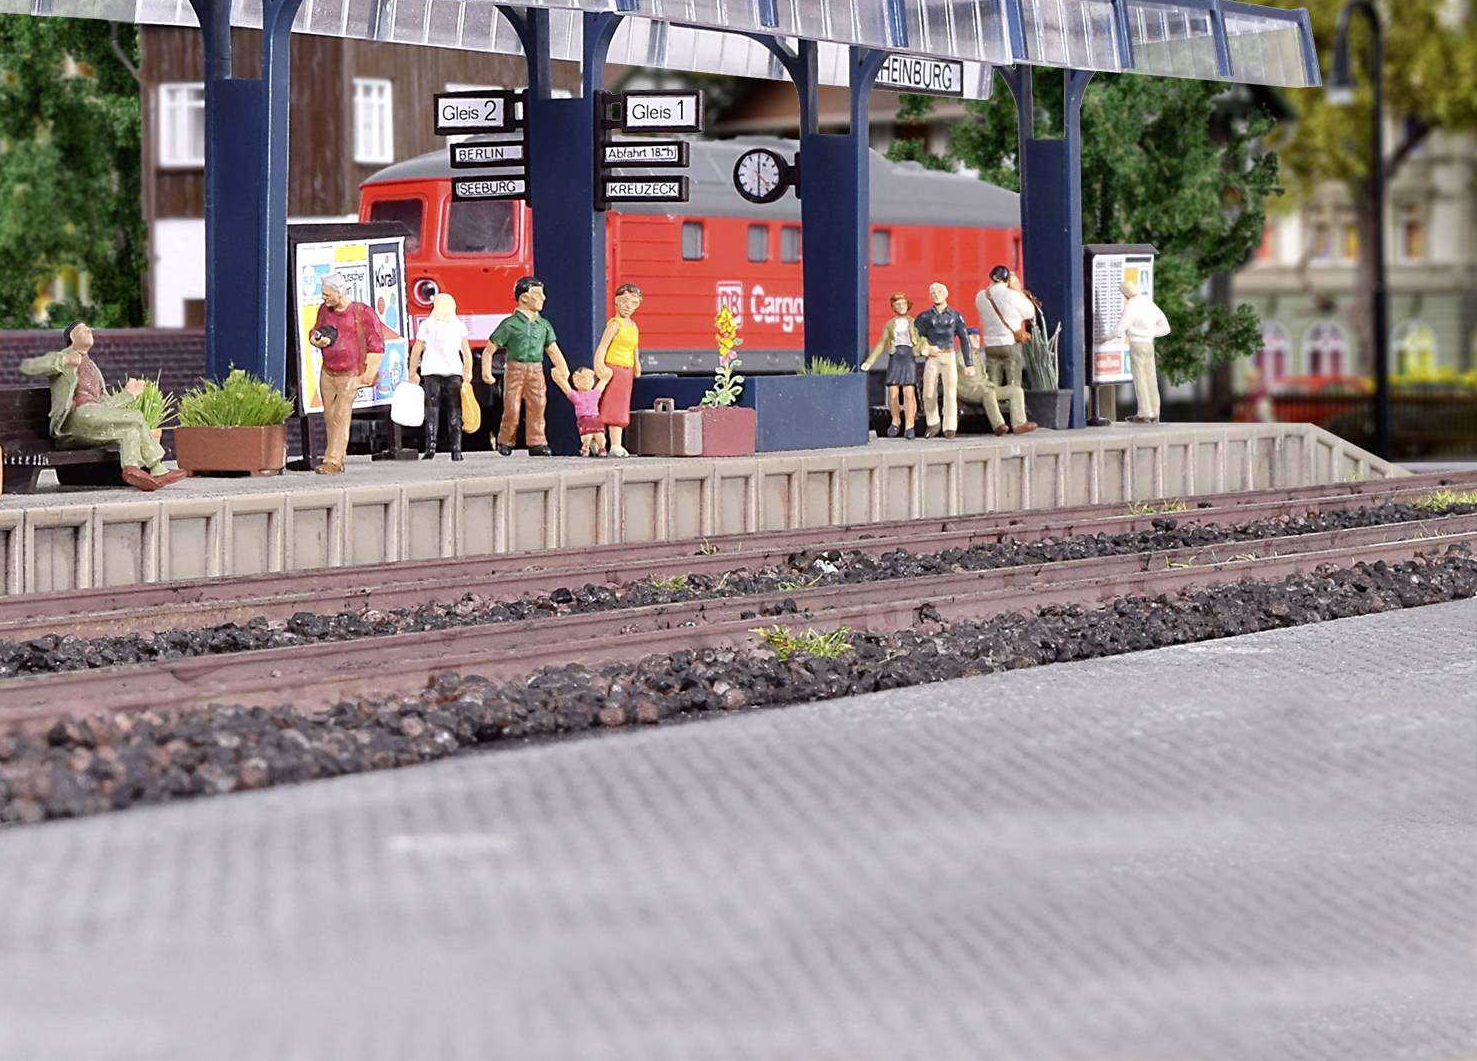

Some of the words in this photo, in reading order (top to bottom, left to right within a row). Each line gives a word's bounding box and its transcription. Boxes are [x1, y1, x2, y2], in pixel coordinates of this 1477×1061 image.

[877, 57, 952, 90] HEINBURG
[442, 105, 479, 121] Gleis
[484, 100, 497, 121] 2
[632, 104, 671, 120] Gleis
[677, 99, 684, 120] 1
[459, 147, 504, 161] BERLIN
[608, 147, 647, 159] Abfahrt
[460, 181, 516, 195] SEEBURG
[610, 183, 677, 195] KREUZECK
